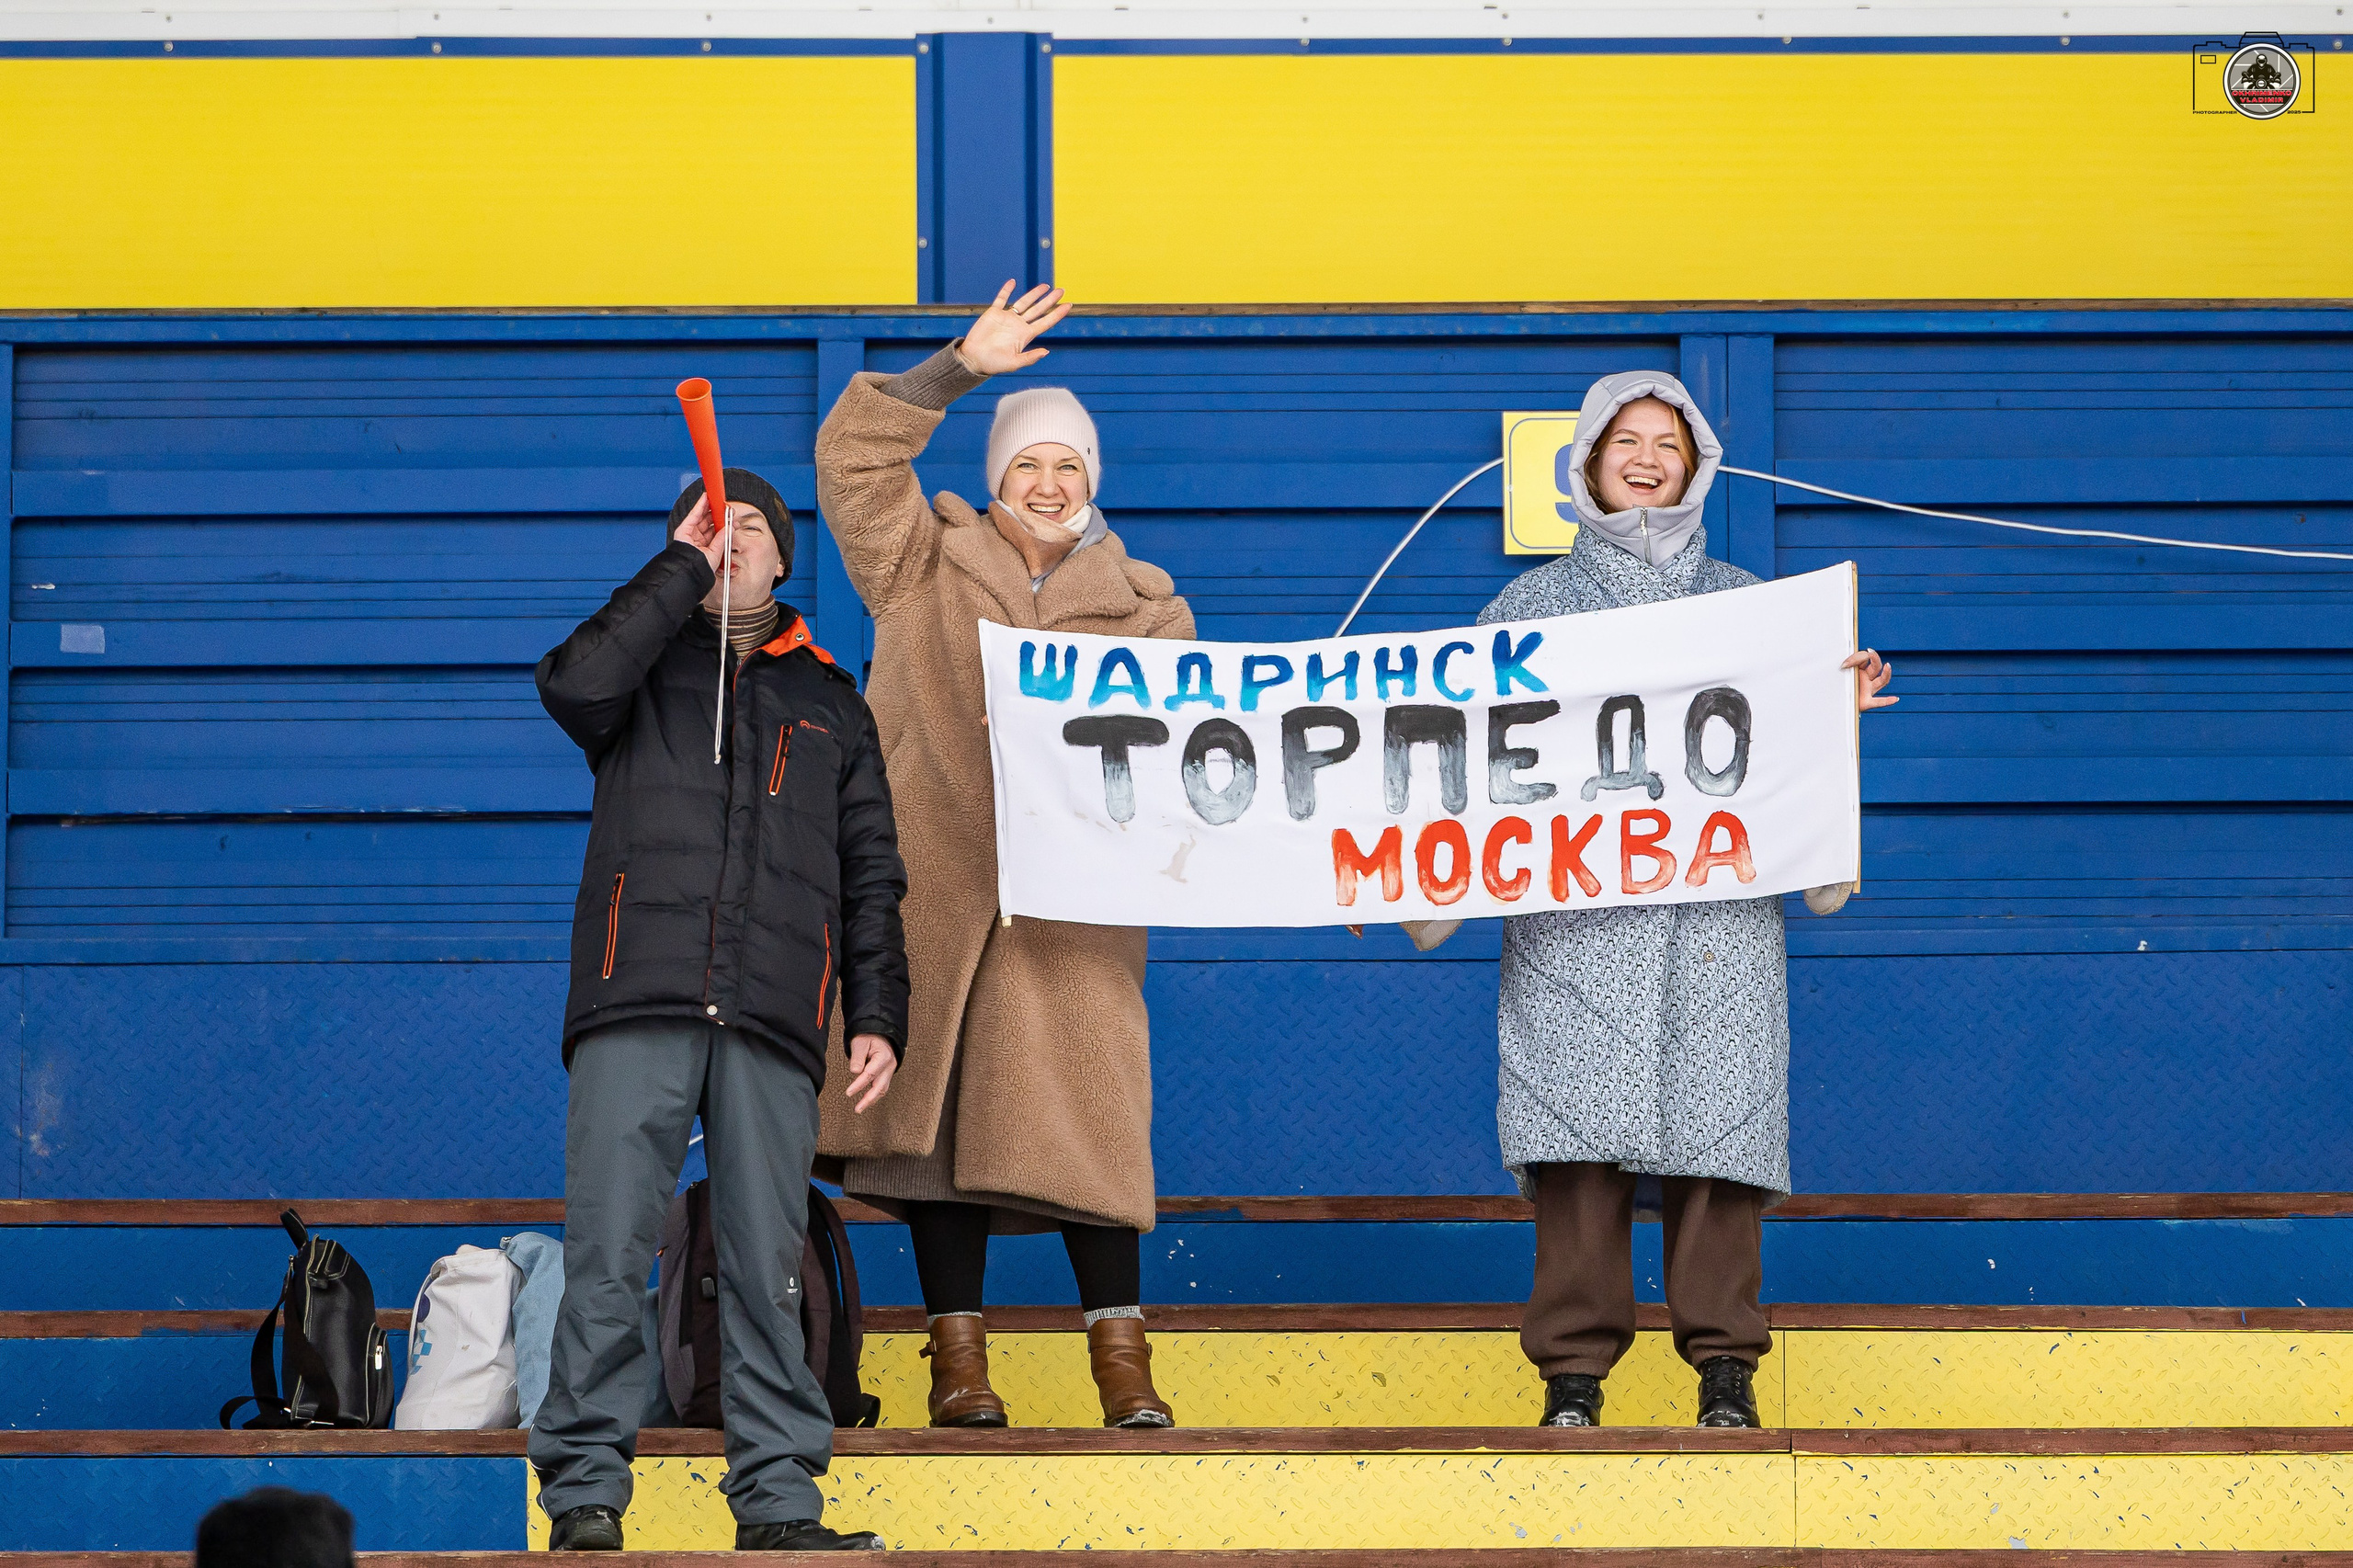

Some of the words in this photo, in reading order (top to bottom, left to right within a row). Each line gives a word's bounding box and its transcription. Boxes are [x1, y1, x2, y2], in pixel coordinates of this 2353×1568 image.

[1018, 630, 1551, 712] ШАДРИНСК
[1063, 686, 1753, 825] ТОРПЕДО
[1332, 808, 1756, 906] МОСКВА
